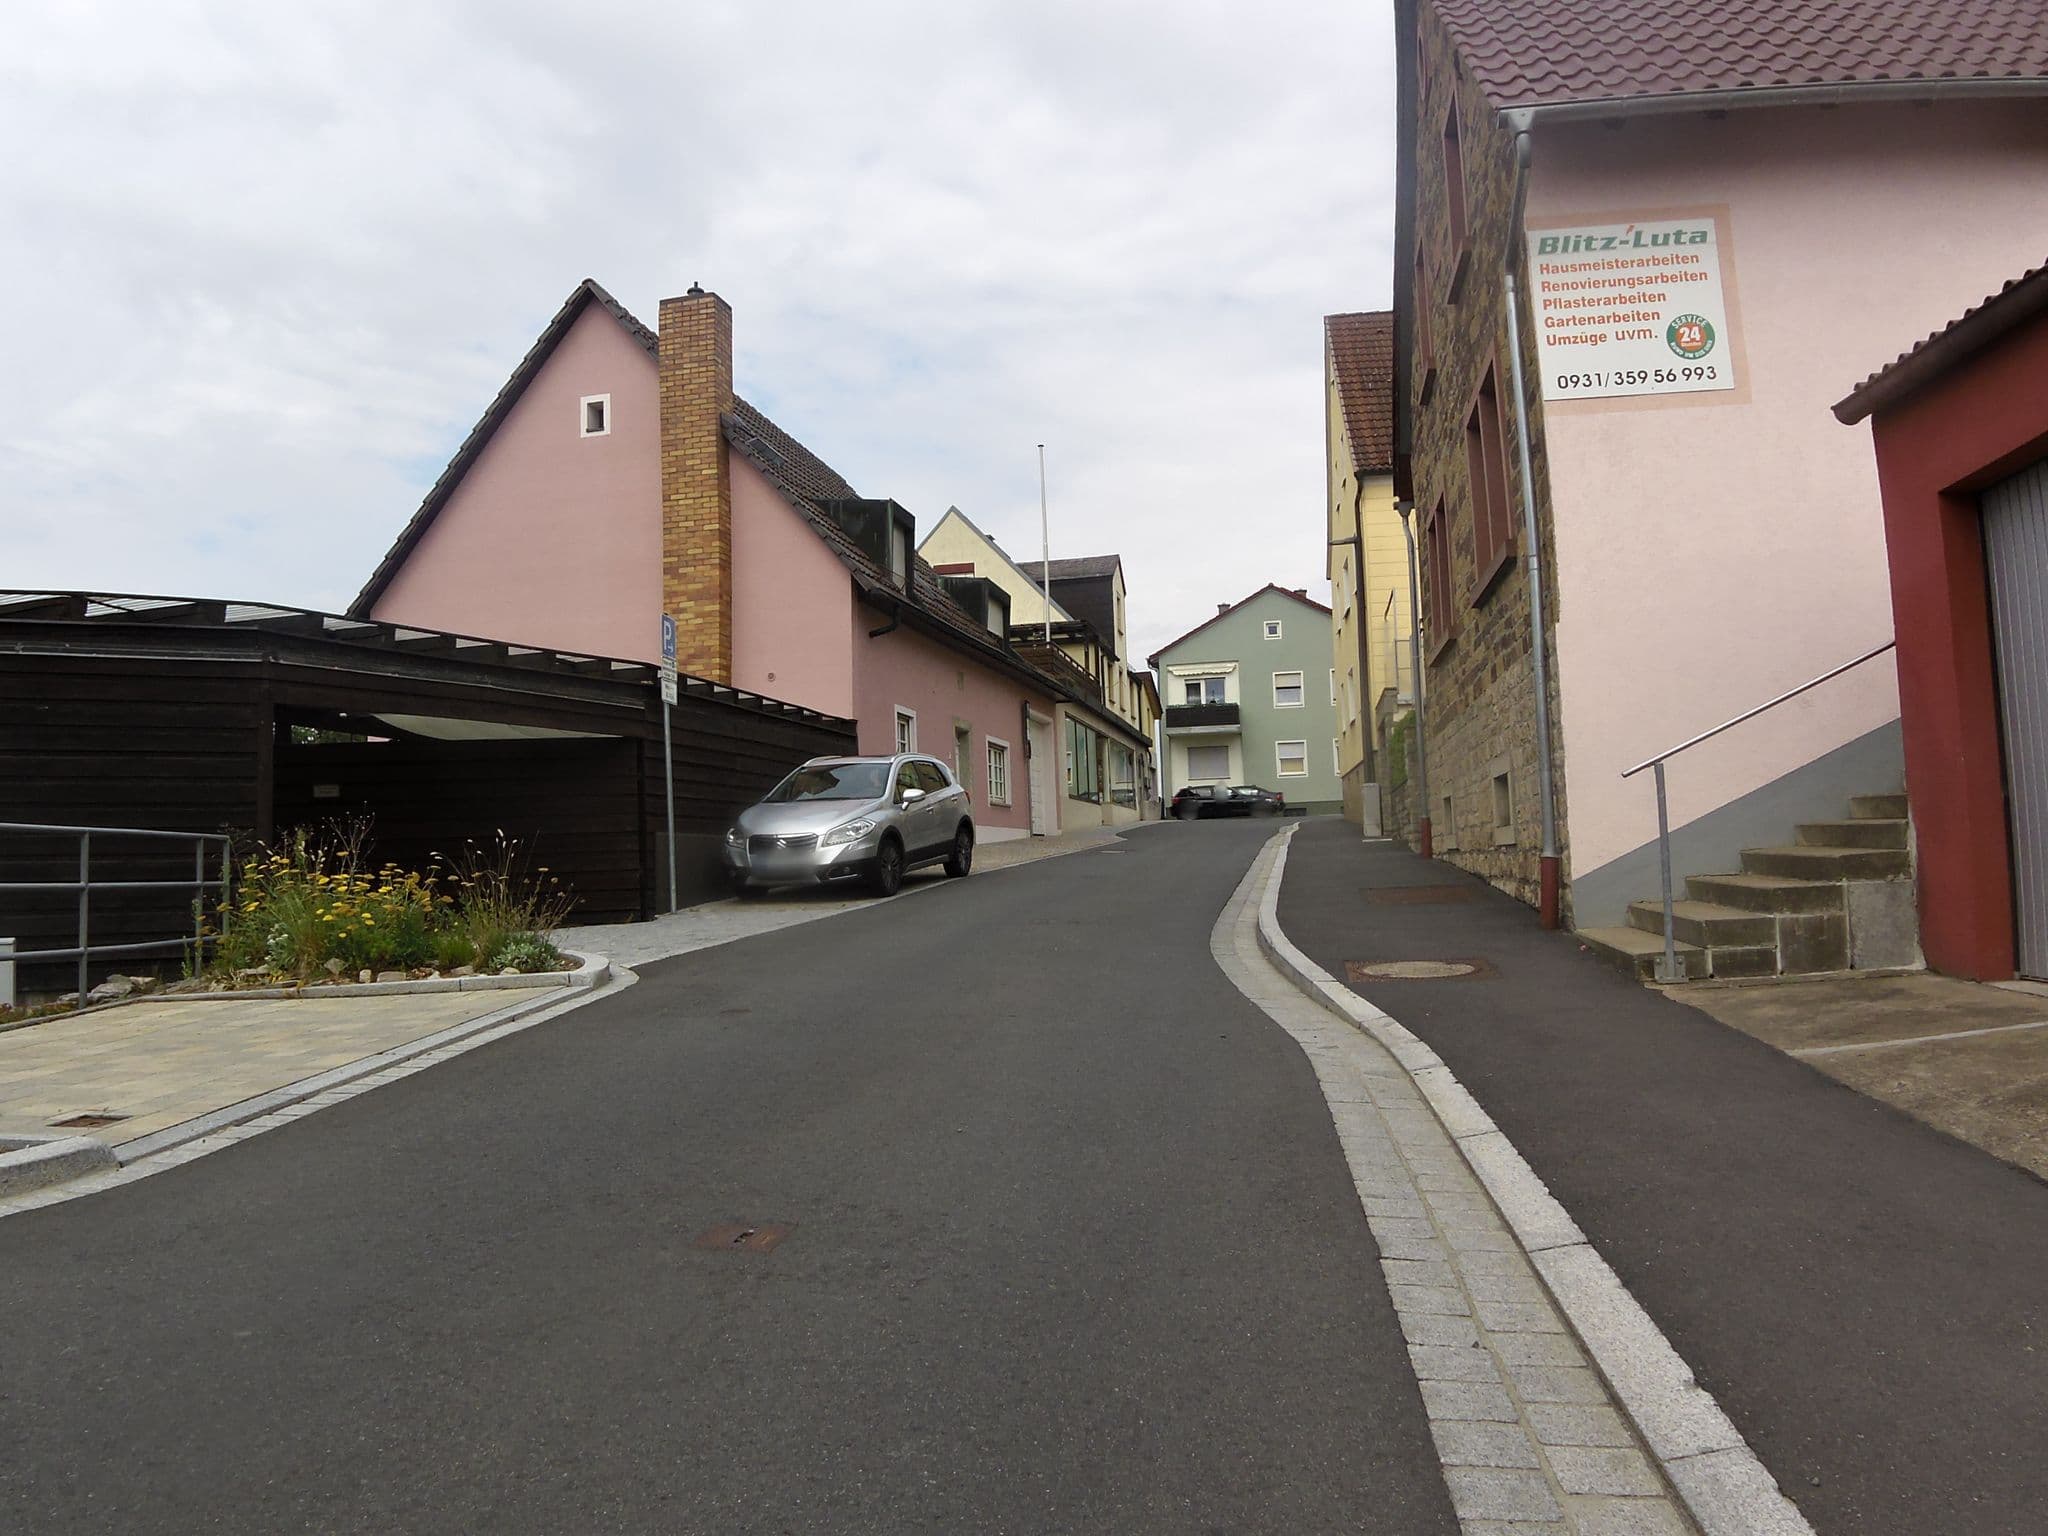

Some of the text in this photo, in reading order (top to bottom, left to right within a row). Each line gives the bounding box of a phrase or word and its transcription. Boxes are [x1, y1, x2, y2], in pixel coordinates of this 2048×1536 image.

[1538, 228, 1708, 255] Blitz-Luta
[1540, 253, 1699, 275] Hausmeisterarbeiten
[1541, 270, 1708, 293] Renovierungsarbeiten
[1542, 291, 1666, 310] Pflasterarbeiten
[1544, 310, 1660, 328] Gartenarbeiten
[1672, 315, 1707, 328] SERVICE
[1546, 328, 1658, 347] Umzüge uvm.
[1680, 326, 1701, 341] 24
[1654, 368, 1677, 383] 56
[1682, 366, 1717, 381] 993
[663, 620, 672, 650] P
